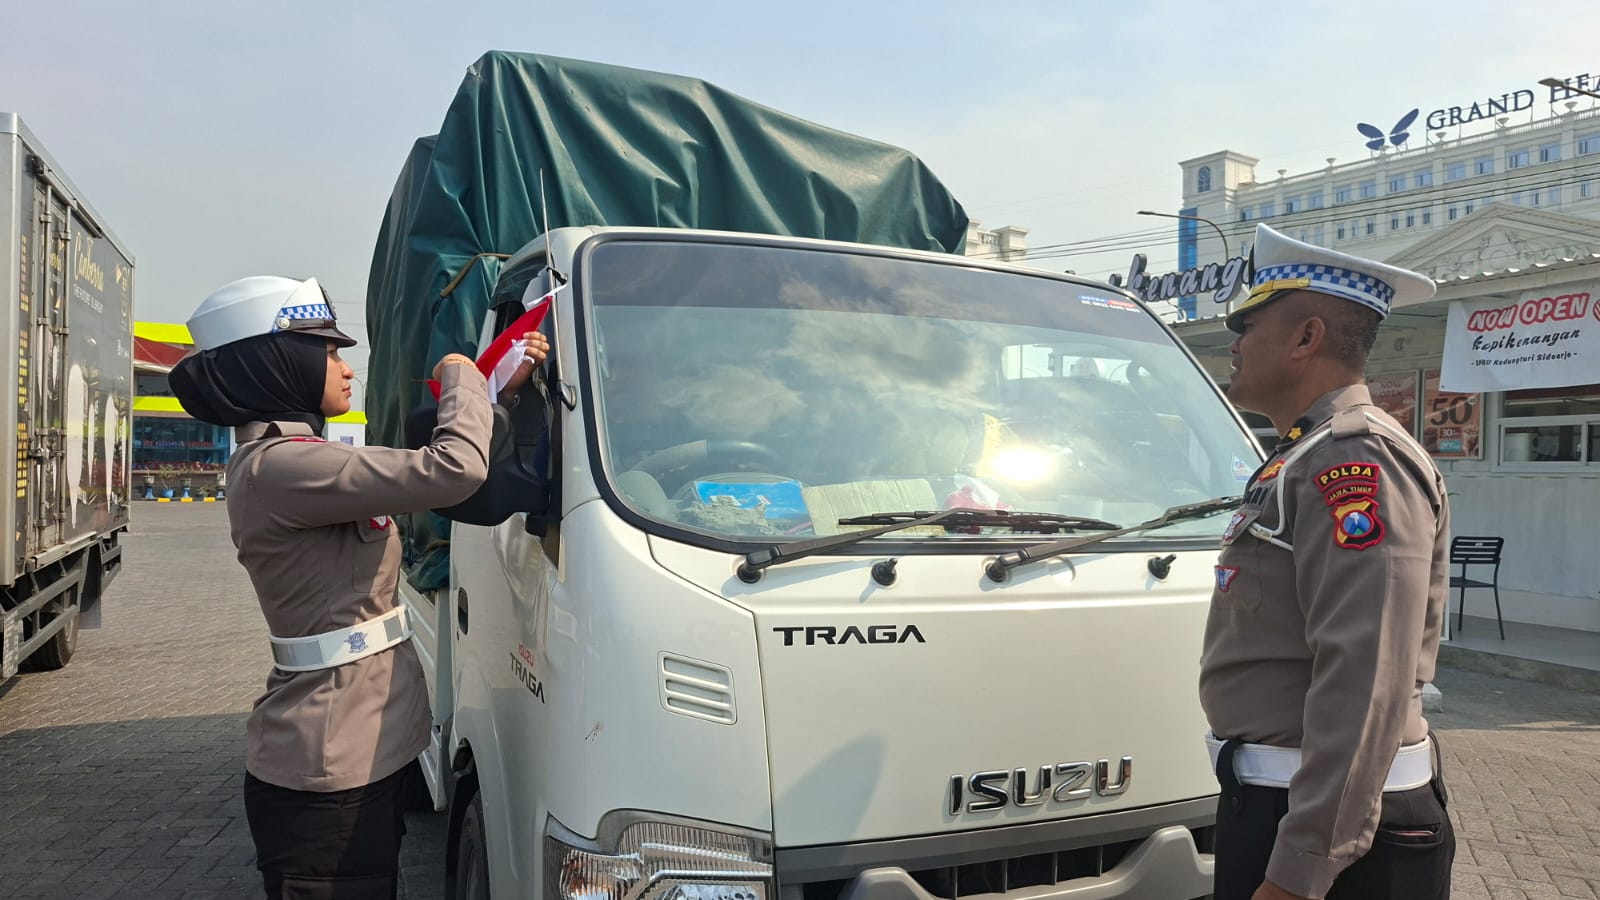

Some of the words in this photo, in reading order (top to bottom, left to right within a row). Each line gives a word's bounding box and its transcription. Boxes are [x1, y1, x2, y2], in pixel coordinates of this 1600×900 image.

[1426, 89, 1535, 130] GRAND
[1467, 305, 1517, 331] NOW
[1520, 294, 1589, 325] OPEN
[1320, 466, 1372, 484] POLDA
[773, 625, 926, 646] TRAGA
[509, 651, 545, 704] TRAGA
[949, 756, 1132, 815] ISUZU
